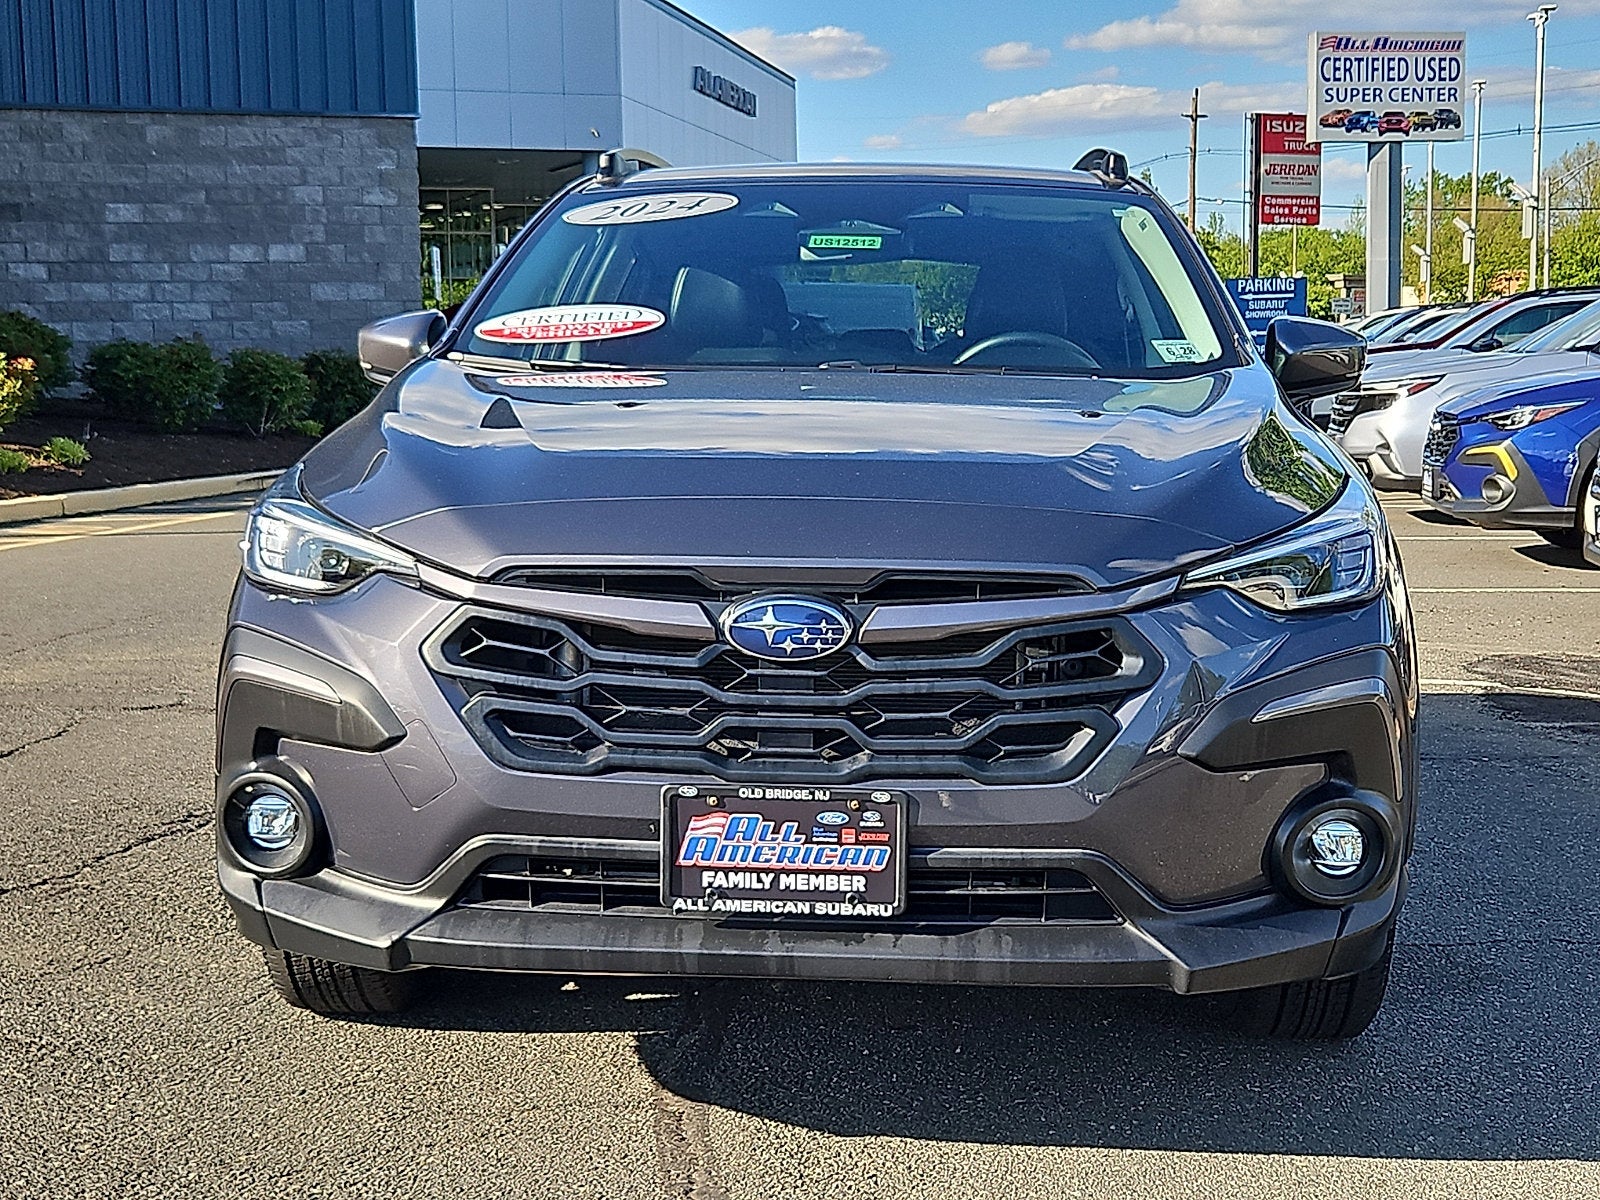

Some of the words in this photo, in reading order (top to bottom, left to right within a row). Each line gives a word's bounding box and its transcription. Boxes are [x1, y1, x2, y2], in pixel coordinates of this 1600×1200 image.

[1334, 36, 1370, 52] ALL
[1371, 36, 1464, 52] AMERICAN
[1320, 57, 1409, 82] CERTIFIED
[1414, 57, 1461, 82] USED
[1324, 87, 1383, 103] SUPER
[1388, 87, 1458, 103] CENTER
[1266, 120, 1305, 133] ISUZ
[1284, 141, 1316, 151] TRUCK
[1265, 197, 1317, 205] Commercial
[590, 196, 710, 221] 2024
[1264, 206, 1289, 214] Sales
[1292, 206, 1317, 215] Parts
[1273, 216, 1307, 224] Service
[813, 237, 876, 247] US12512
[1237, 278, 1295, 292] PARKING
[1248, 300, 1285, 309] SUBARU
[502, 309, 642, 327] CERTIFIED
[521, 327, 614, 339] VEHICLE
[1179, 346, 1196, 355] 28
[738, 787, 764, 799] OLD
[814, 790, 831, 801] NJ
[723, 813, 806, 844] ALL
[680, 835, 891, 870] AMERICAN
[701, 870, 774, 891] FAMILY
[779, 873, 867, 892] MEMBER
[672, 898, 710, 913] ALL
[711, 899, 811, 915] AMERICAN
[814, 901, 893, 917] SUBARU
